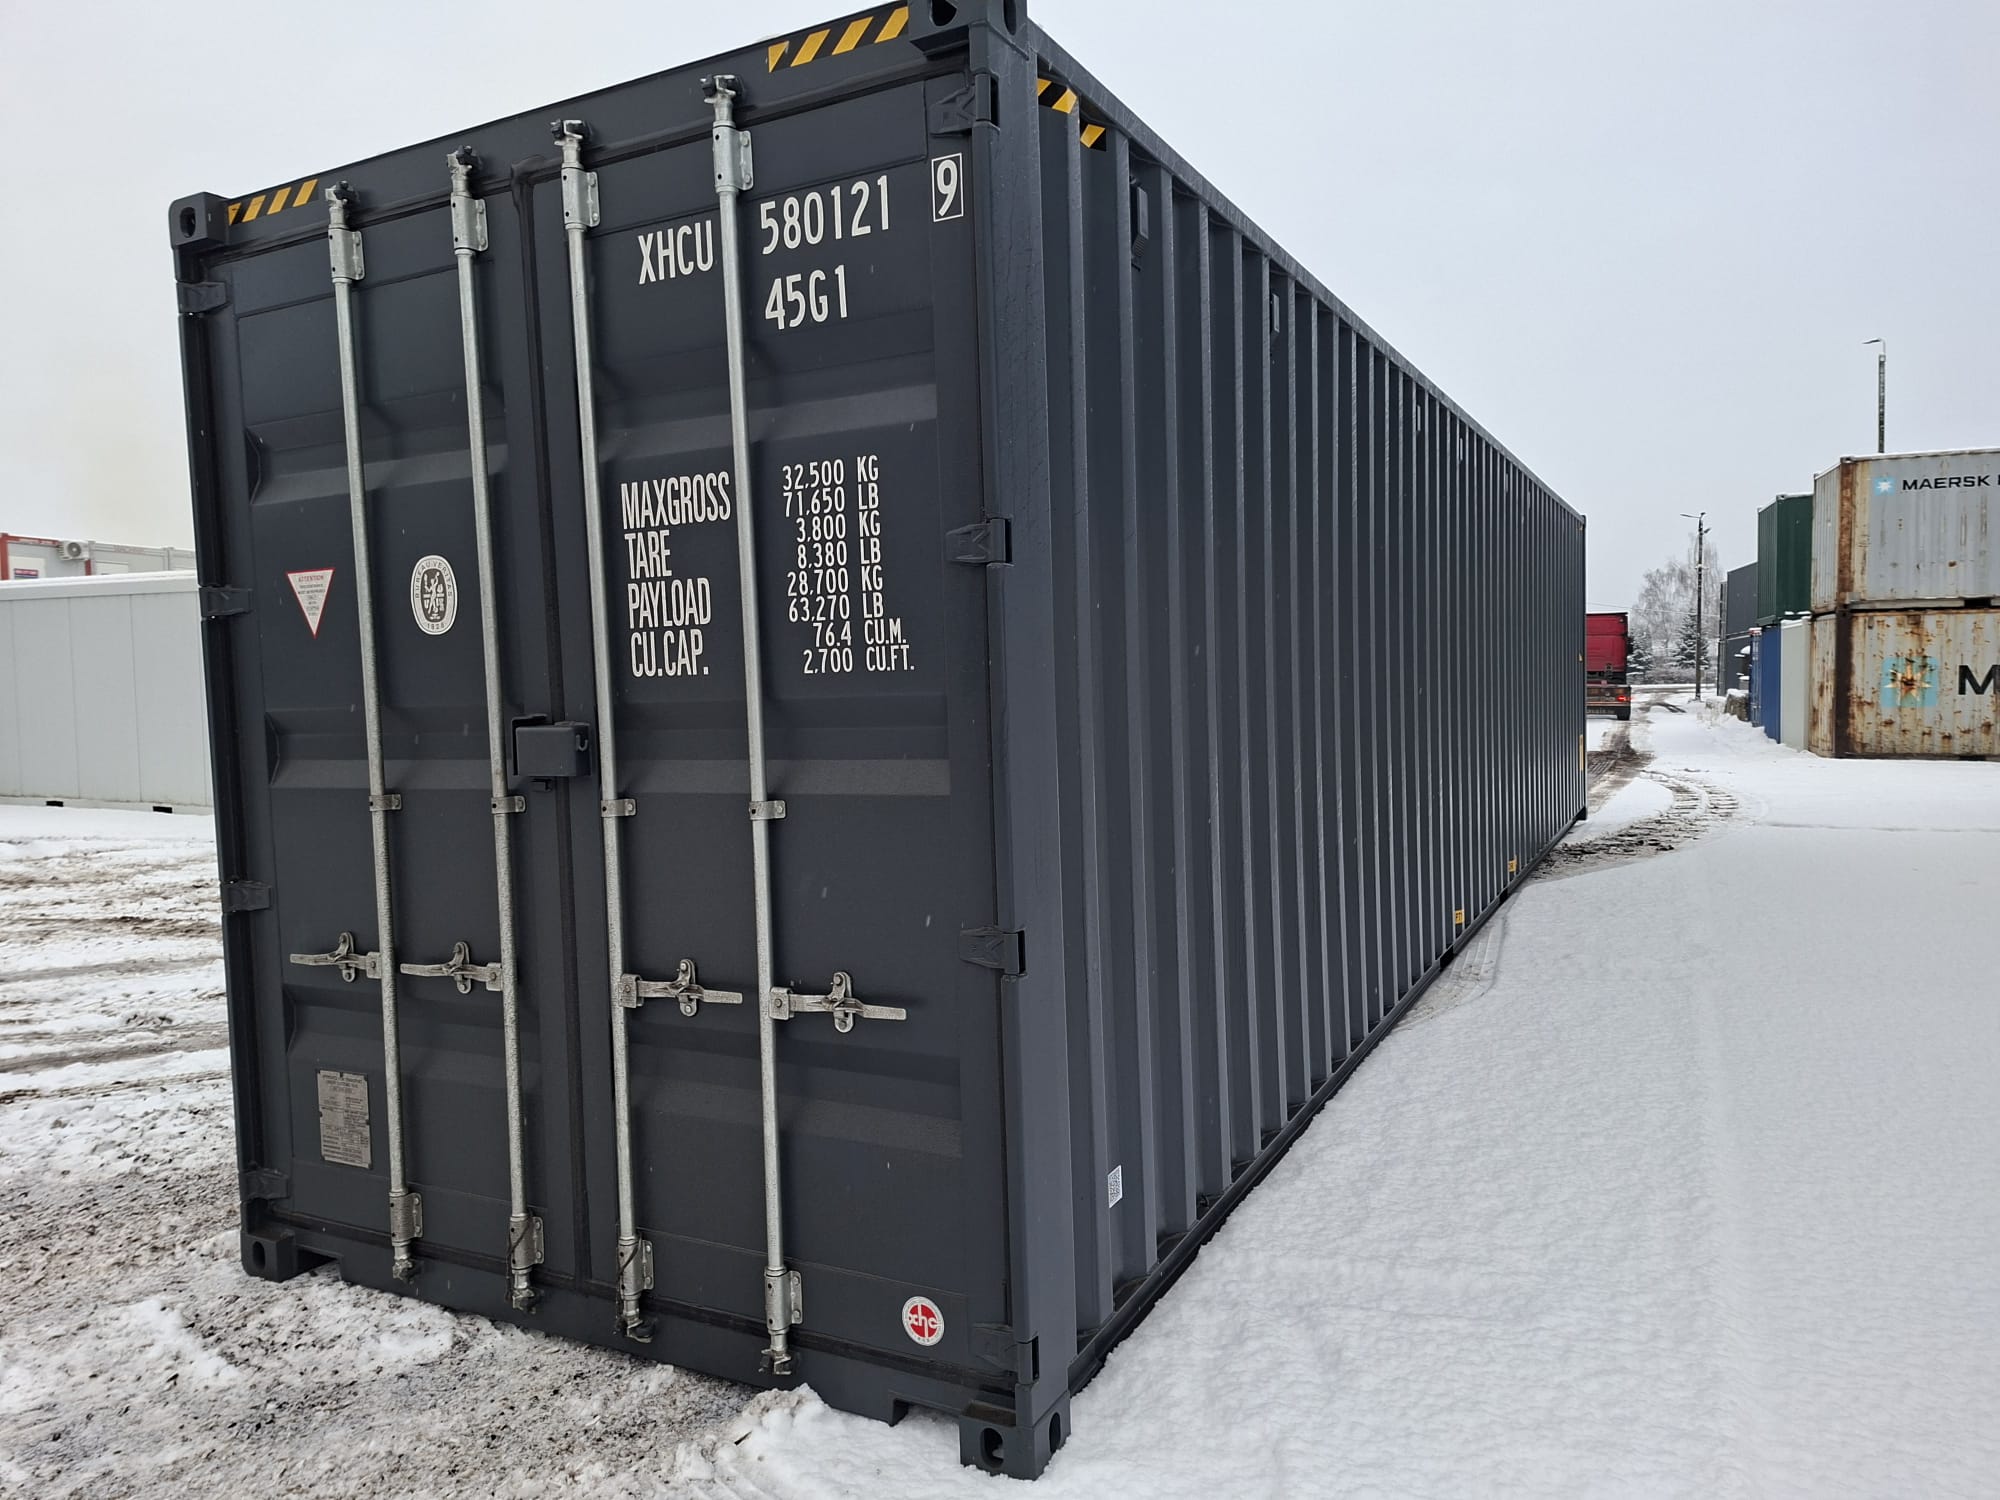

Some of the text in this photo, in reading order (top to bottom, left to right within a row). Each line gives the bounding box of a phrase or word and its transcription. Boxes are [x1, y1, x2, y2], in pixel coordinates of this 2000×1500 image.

[638, 159, 958, 285] XHCU 580121 9
[765, 264, 849, 330] 45G1
[620, 454, 879, 530] MAXGROSS 32,500 KG
[783, 482, 880, 518] 71,650 LB
[1902, 474, 1991, 491] MAERSK
[624, 509, 881, 580] TARE 3,800 KG
[797, 537, 881, 569] 8,380 LB
[627, 564, 884, 630] PAYLOAD 28,700 KG
[788, 591, 884, 623] 63,270 LB
[630, 617, 907, 679] CU.CAP. 76.4 CU.M.
[803, 644, 915, 674] 2,700 CU.FT.
